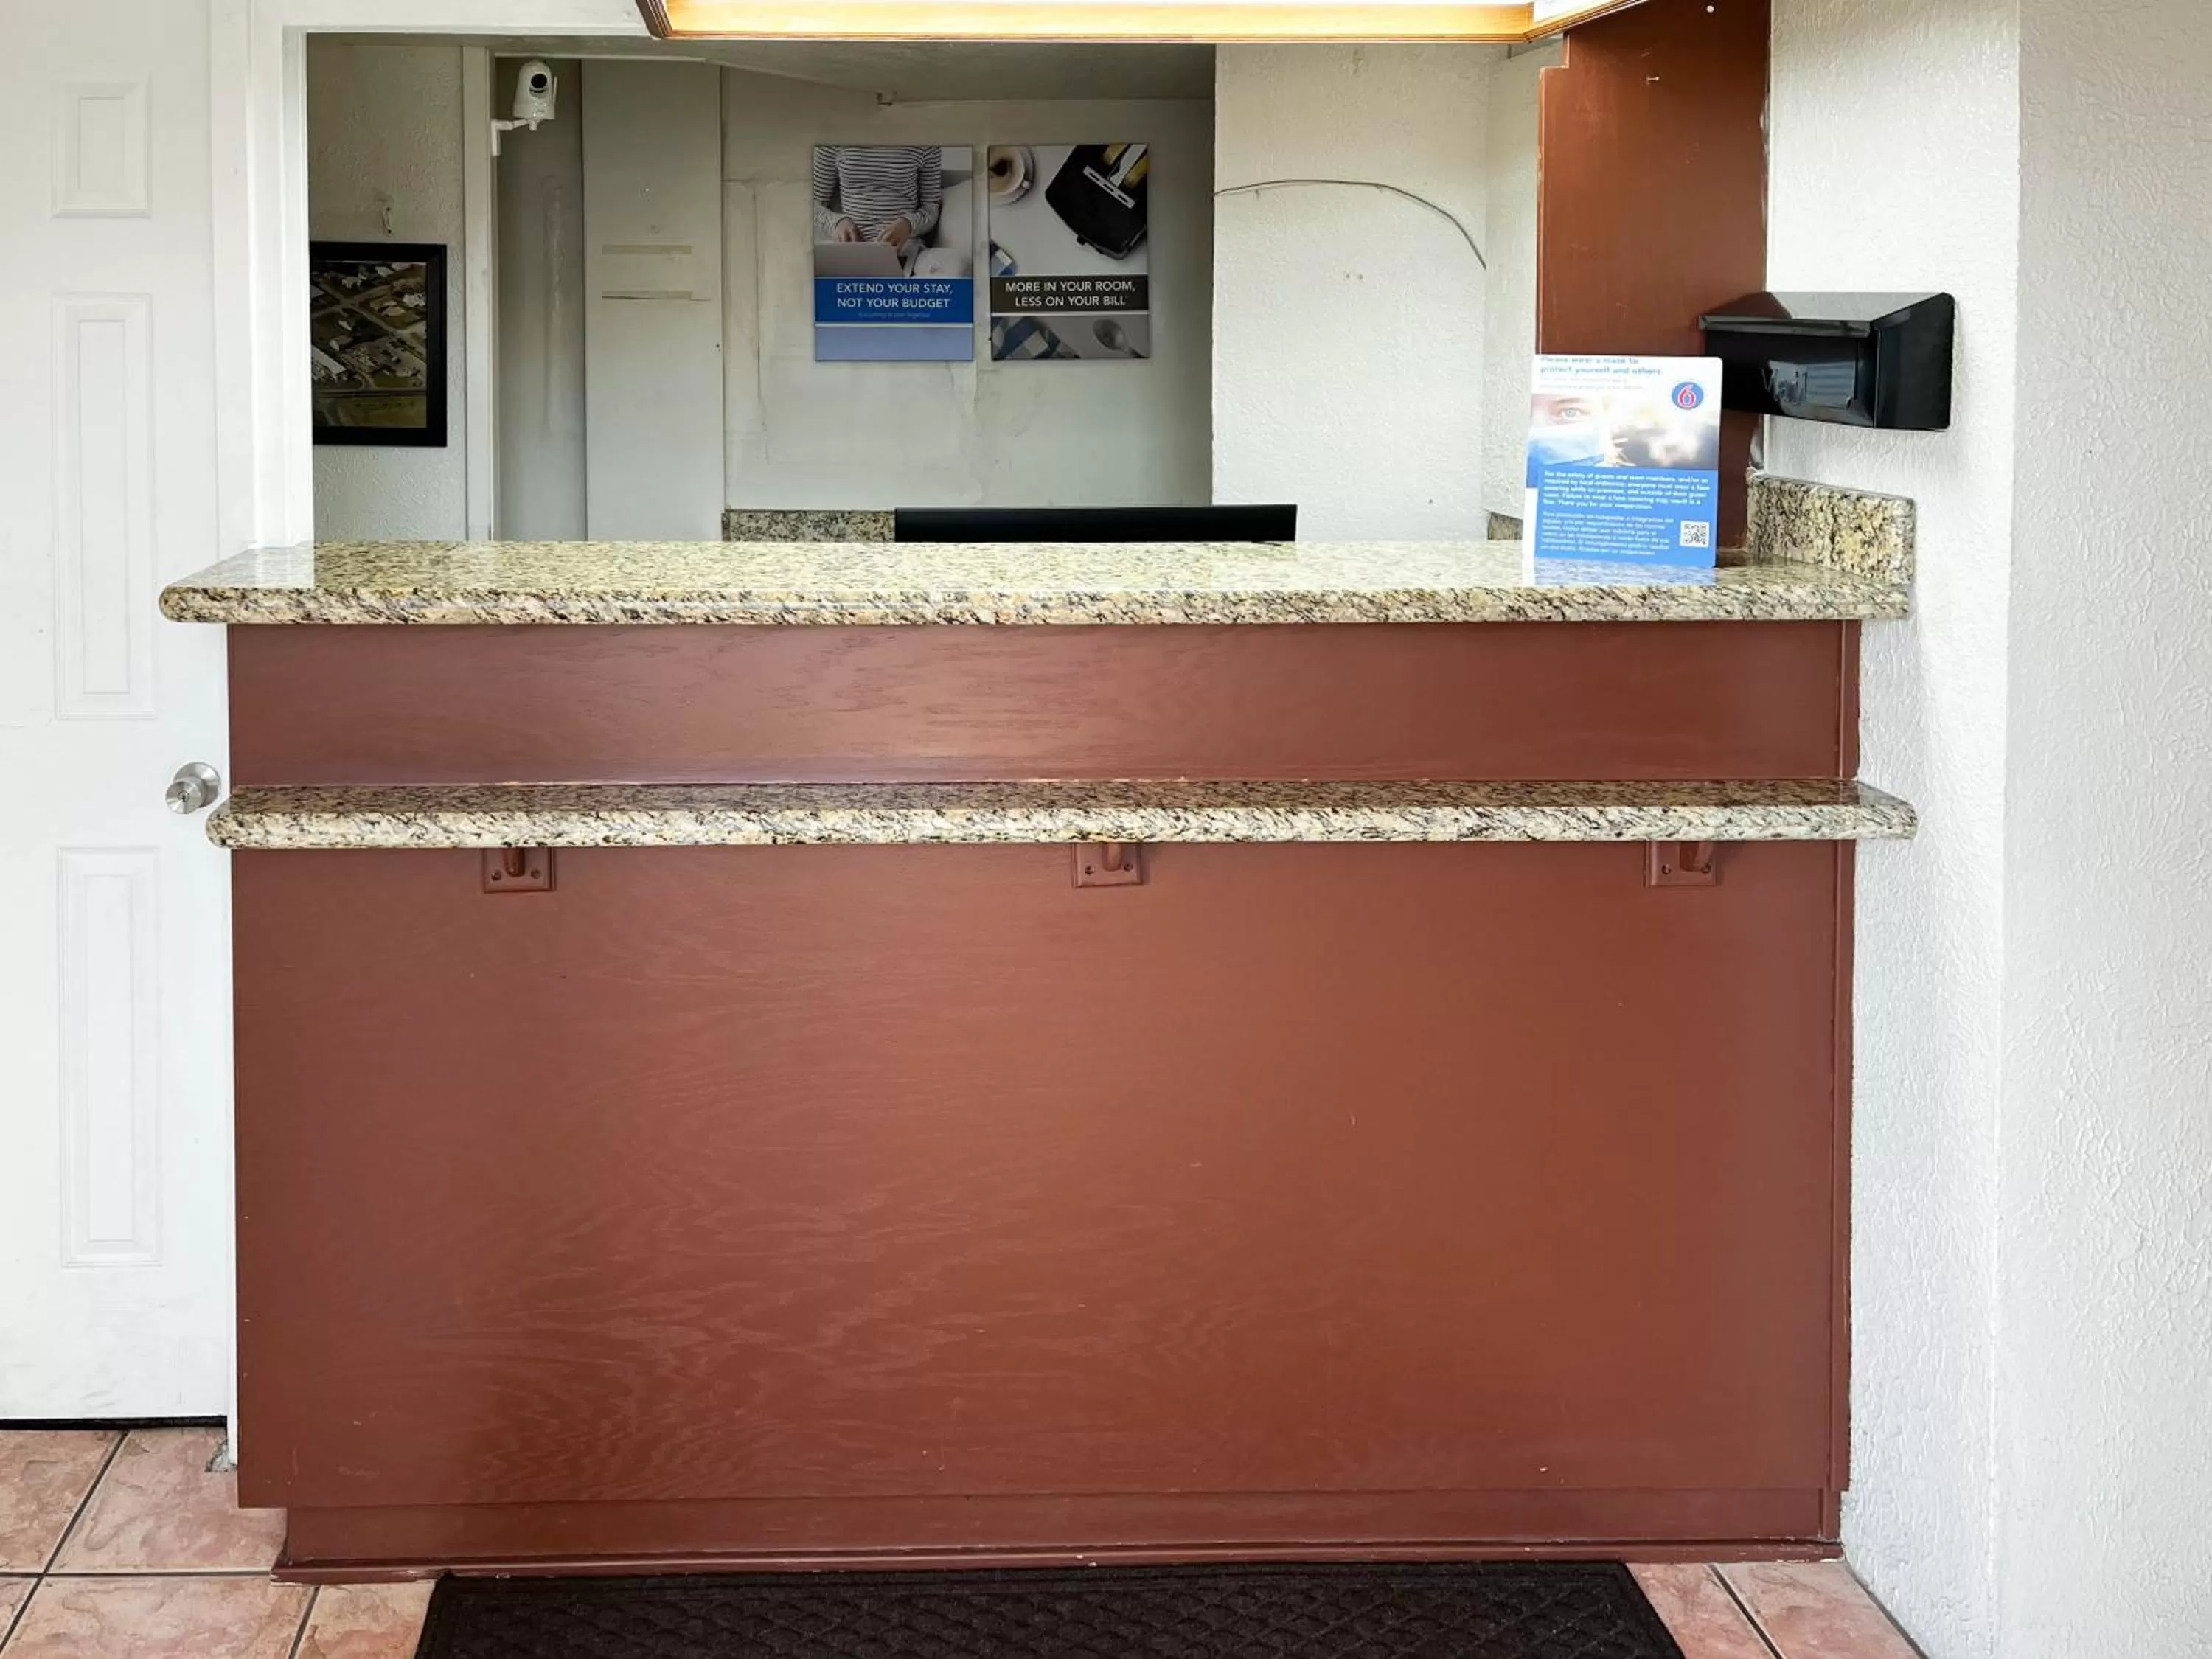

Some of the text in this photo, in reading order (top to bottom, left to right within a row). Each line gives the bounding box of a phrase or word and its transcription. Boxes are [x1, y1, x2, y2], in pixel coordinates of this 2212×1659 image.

[836, 282, 953, 295] EXTEND YOUR STAY,
[1005, 281, 1135, 293] MORE IN YOUR ROOM,
[837, 298, 951, 308] NOT YOUR BUDGET
[1015, 296, 1126, 307] LESS ON YOUR BILL
